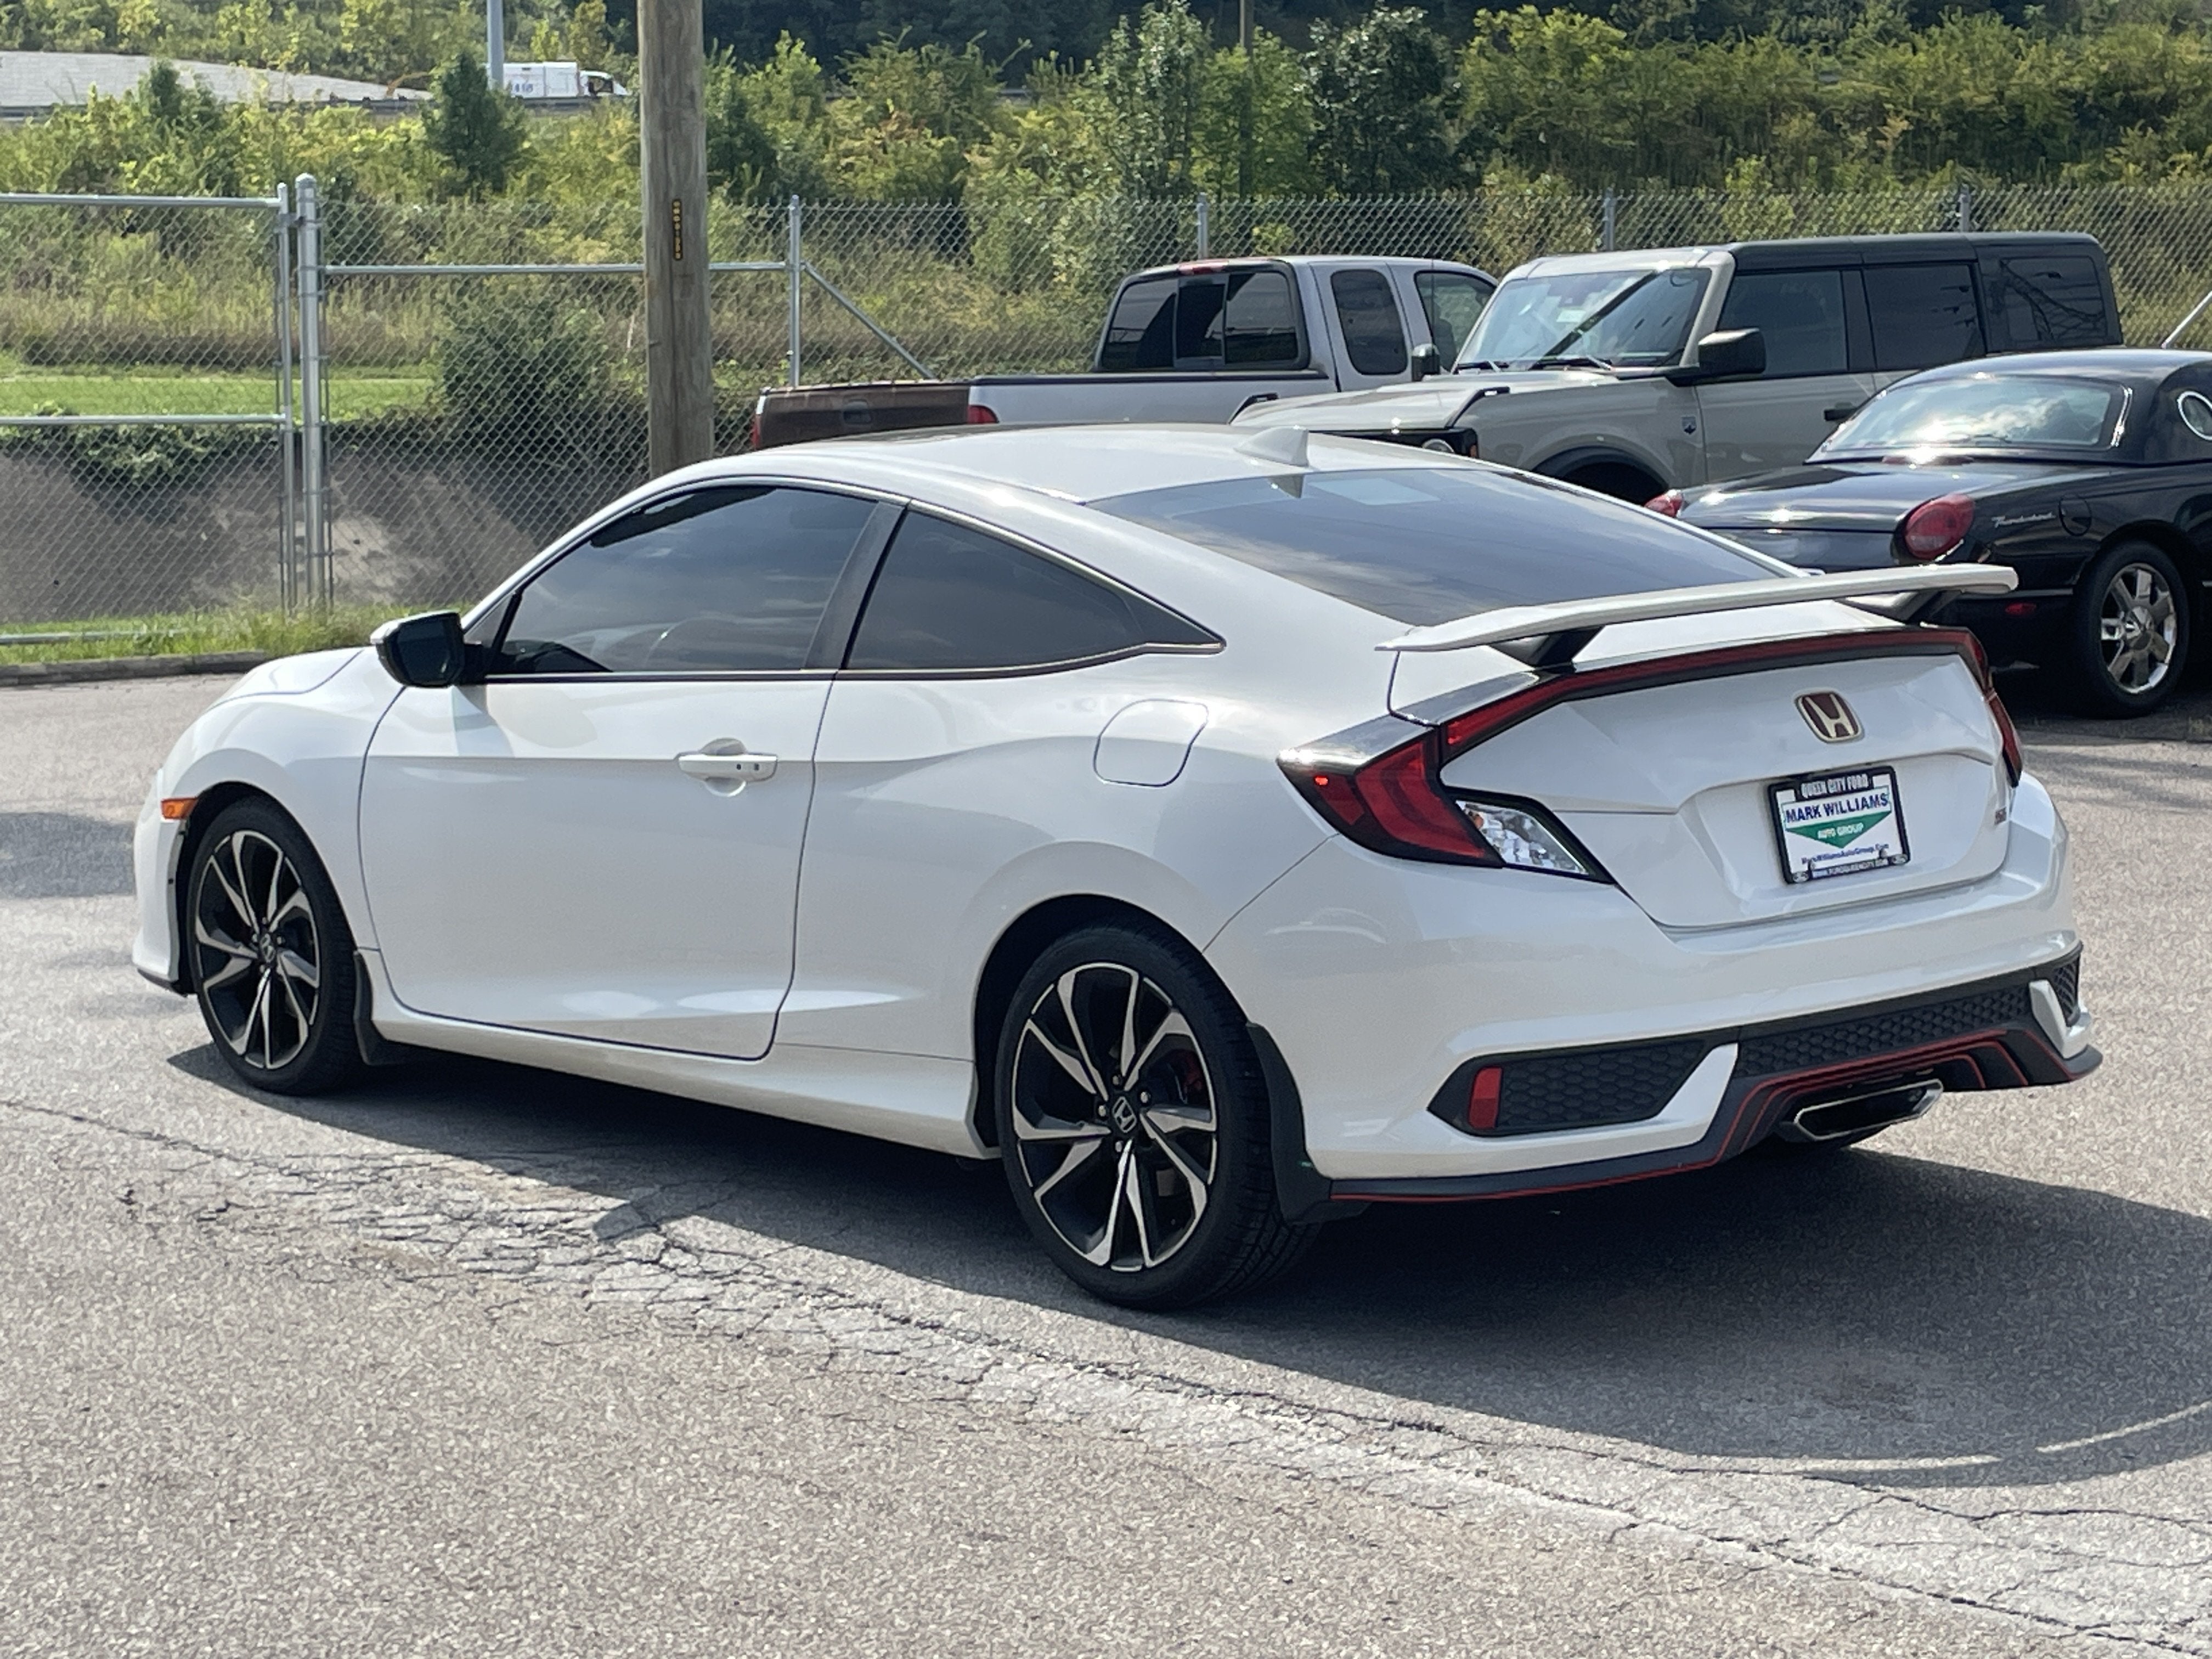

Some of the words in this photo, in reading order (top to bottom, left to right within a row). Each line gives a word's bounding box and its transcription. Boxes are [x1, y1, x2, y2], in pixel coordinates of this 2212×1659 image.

[1786, 804, 1821, 823] MARK
[1823, 793, 1888, 816] WILLIAMS
[1837, 822, 1864, 836] GROUP
